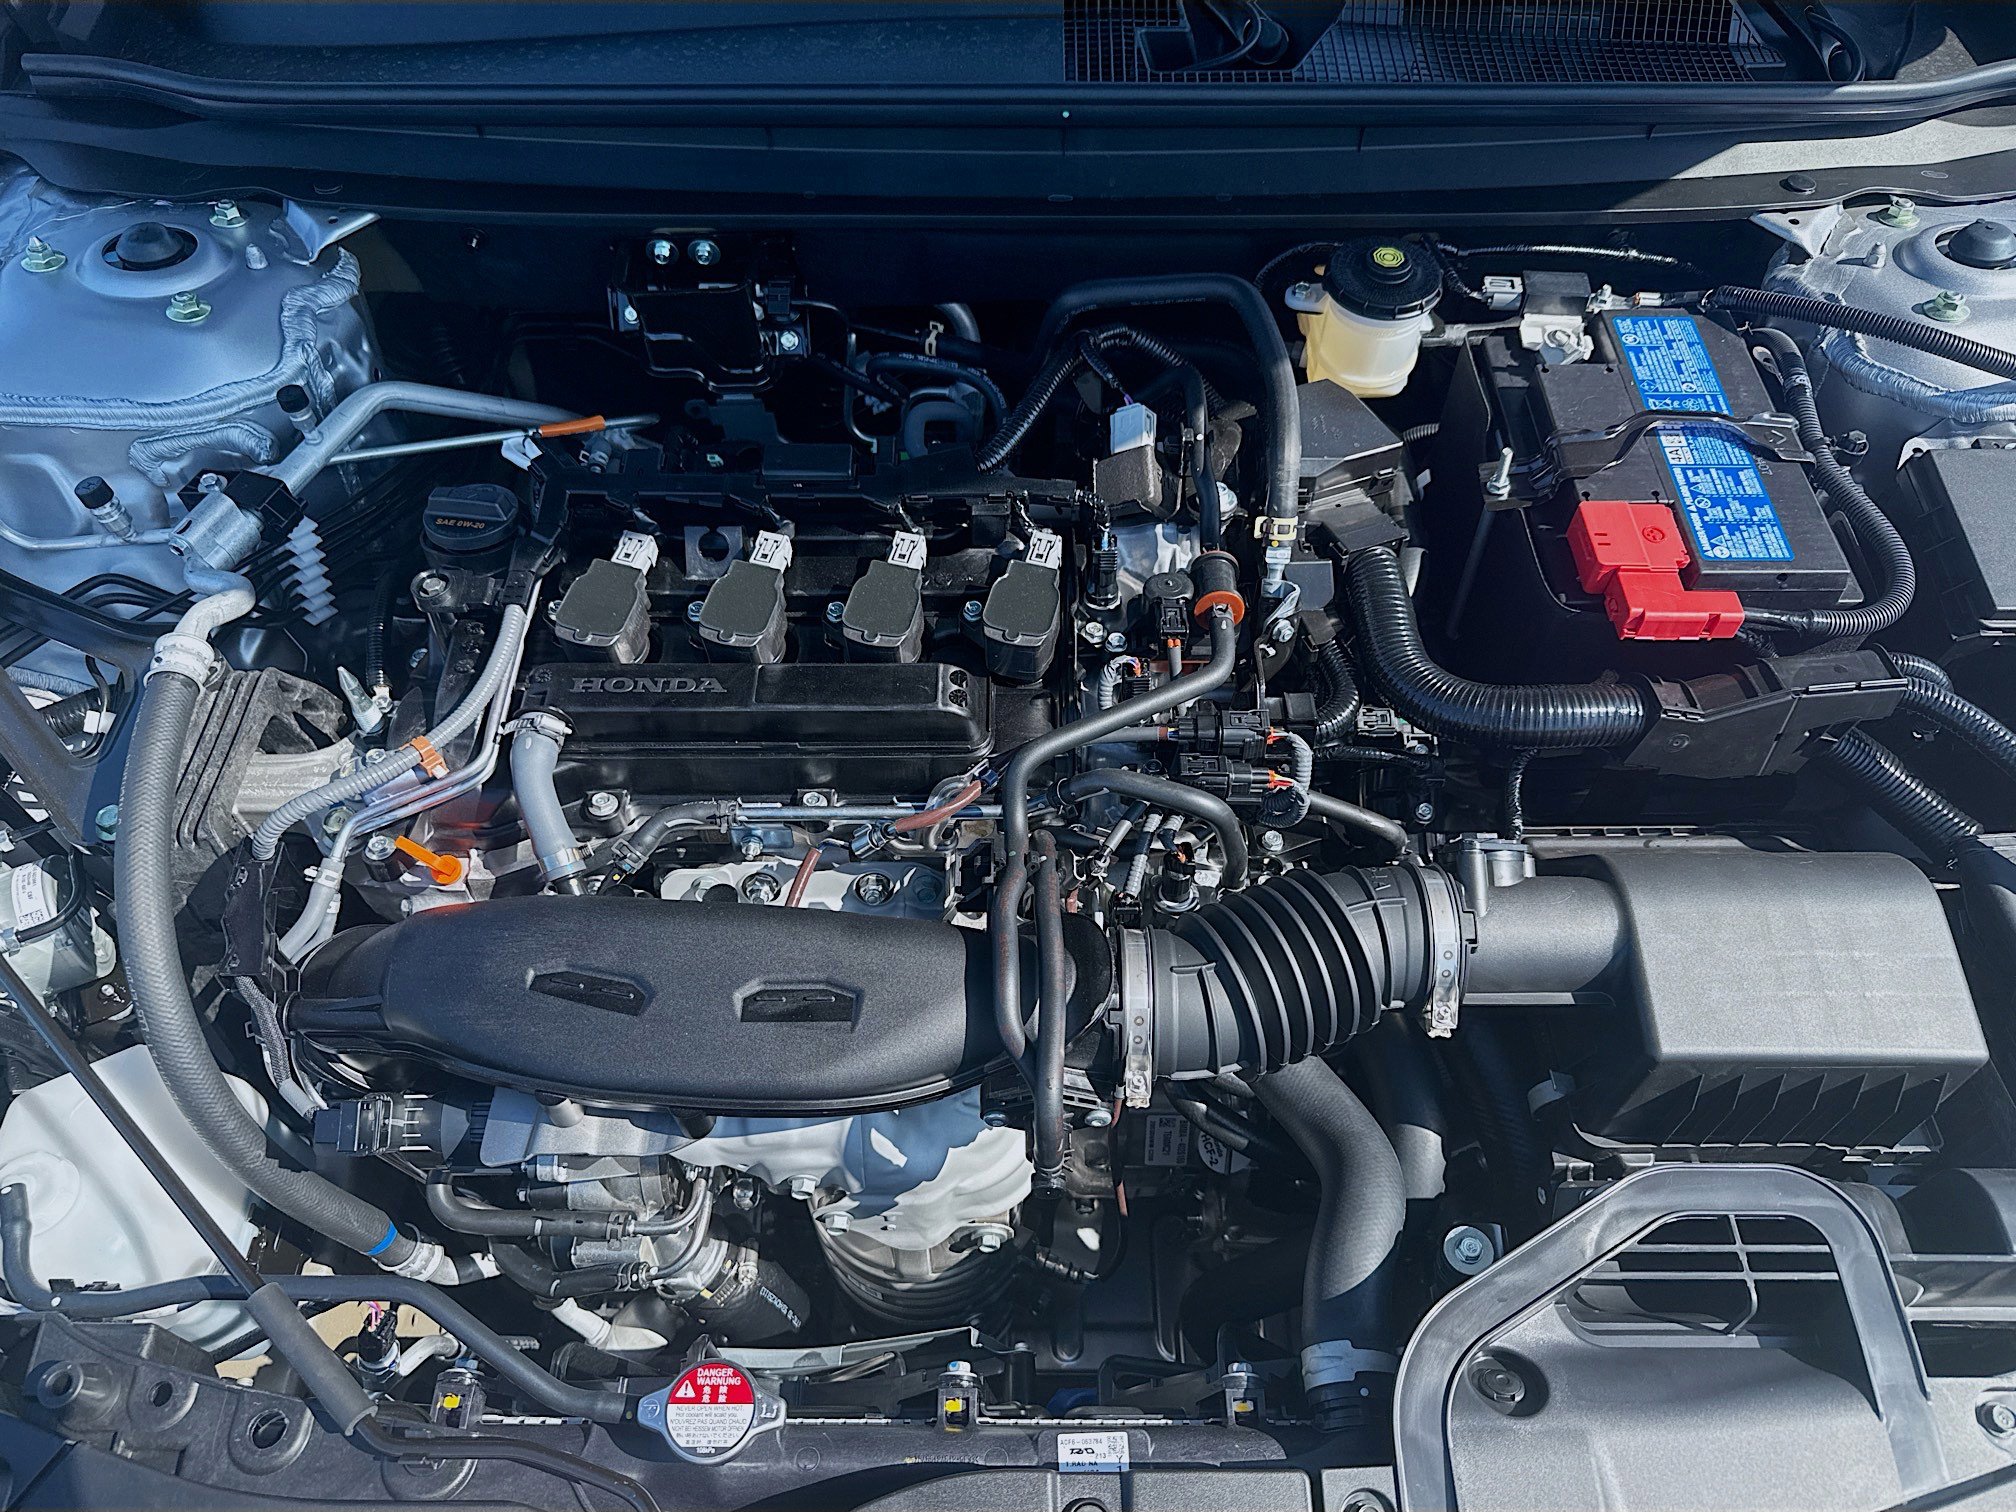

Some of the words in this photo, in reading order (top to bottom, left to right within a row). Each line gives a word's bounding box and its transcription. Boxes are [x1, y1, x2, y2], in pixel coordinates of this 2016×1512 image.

[1669, 448, 1682, 462] 4A
[435, 518, 456, 526] SAE
[456, 520, 486, 529] 0W-20
[569, 677, 728, 693] HONDA
[1201, 1134, 1219, 1166] HCF-2
[697, 1368, 734, 1377] DANGER
[696, 1376, 742, 1386] WARNUNG
